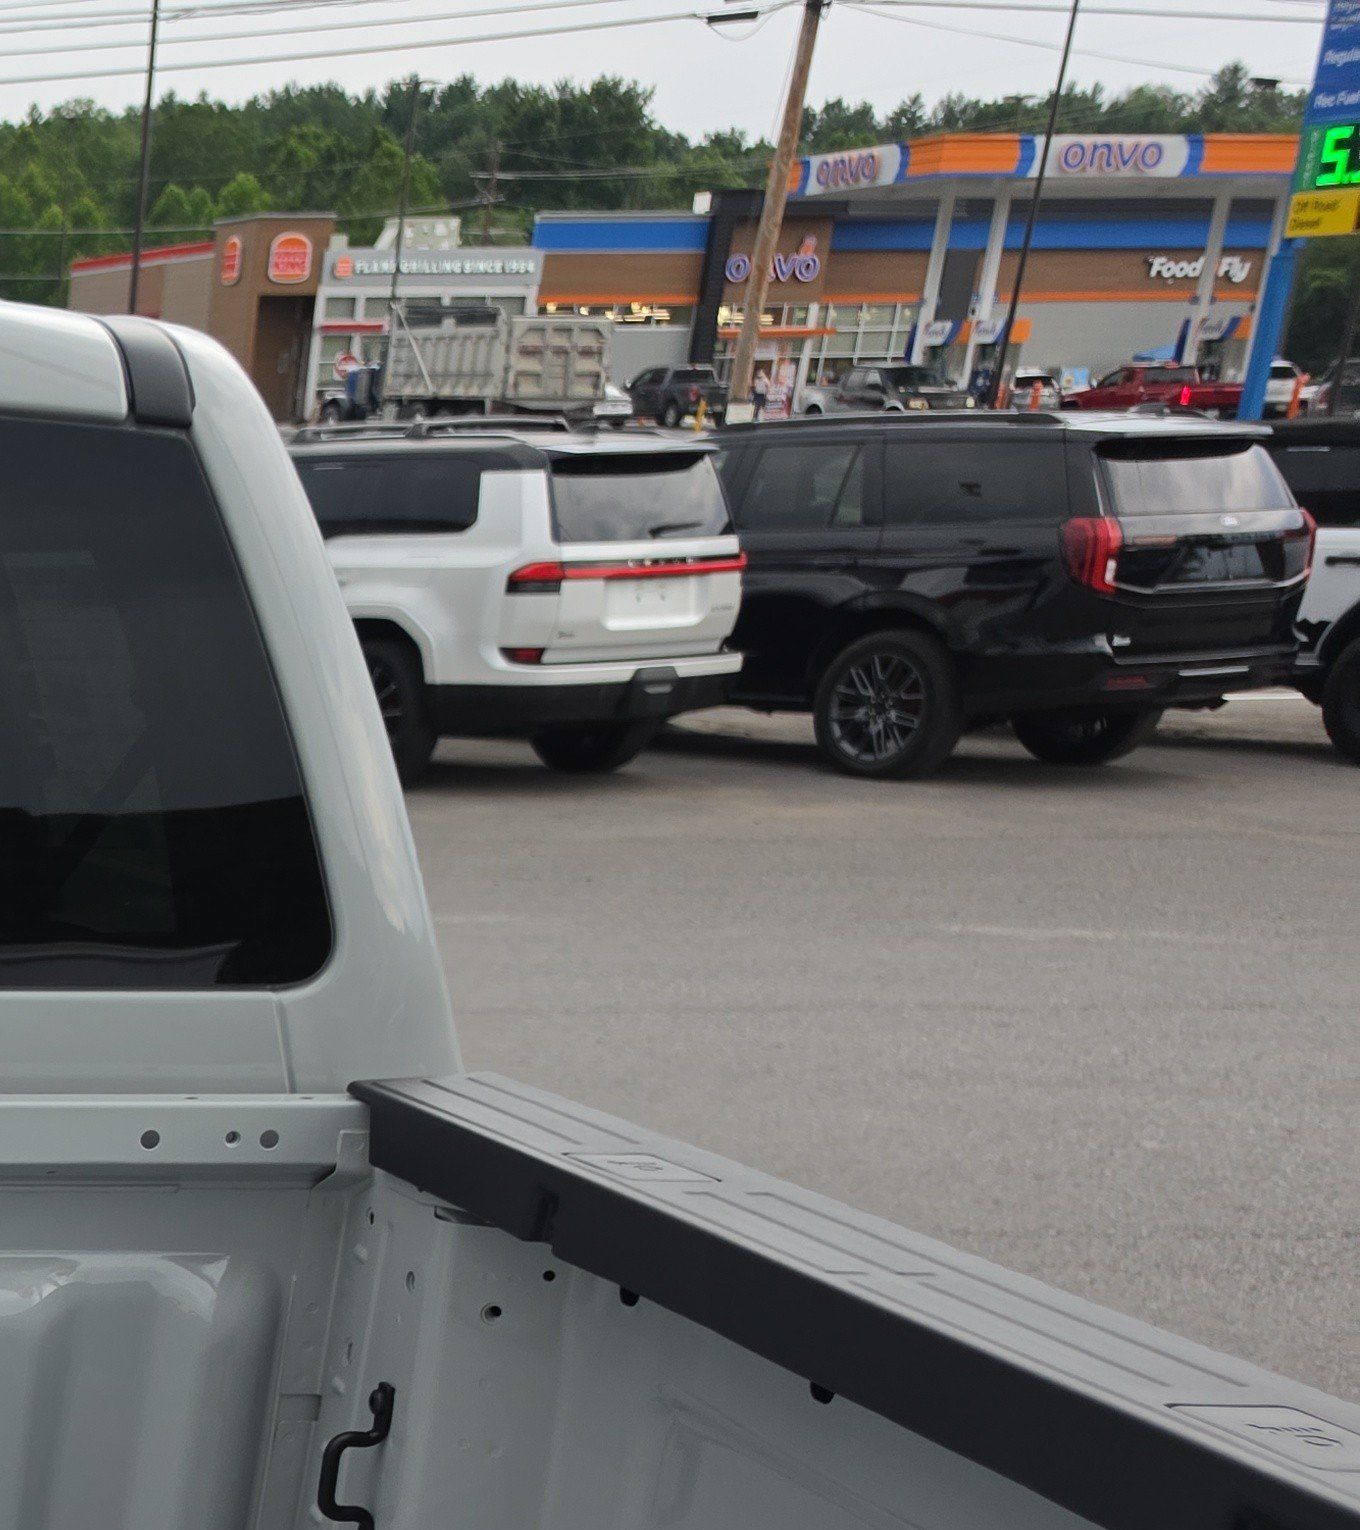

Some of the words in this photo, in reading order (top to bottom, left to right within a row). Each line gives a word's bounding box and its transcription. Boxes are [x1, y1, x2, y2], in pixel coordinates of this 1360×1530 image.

[816, 153, 877, 187] onvo
[1060, 140, 1164, 171] onvo
[725, 253, 820, 283] ovo
[1148, 255, 1206, 278] Food
[1217, 255, 1252, 283] Fly
